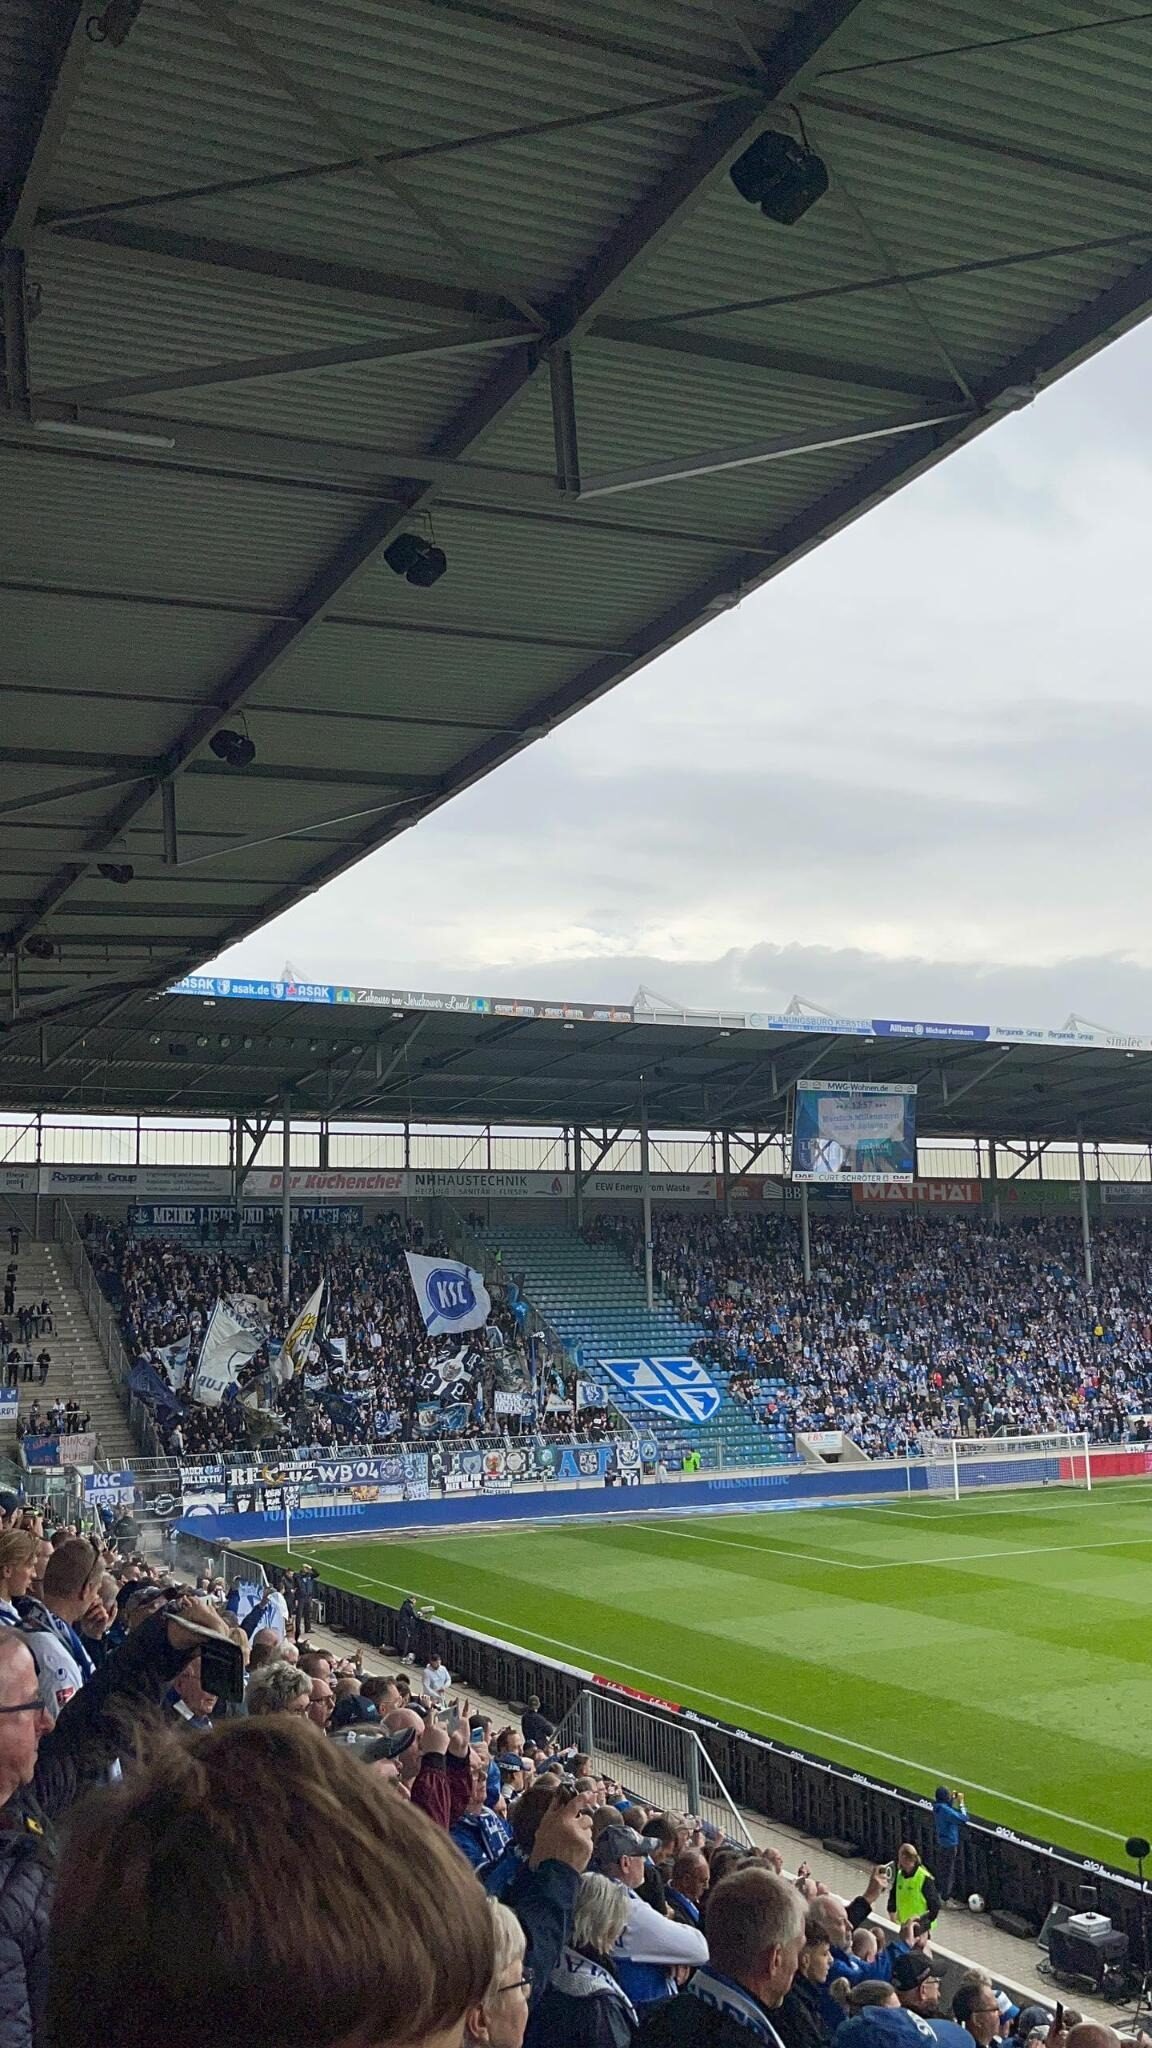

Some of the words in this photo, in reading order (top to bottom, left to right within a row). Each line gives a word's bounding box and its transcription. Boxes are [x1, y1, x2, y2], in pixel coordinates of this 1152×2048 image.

[181, 977, 215, 990] ASAK
[232, 983, 270, 996] asak.de
[298, 986, 330, 998] ASAK
[889, 1023, 914, 1034] Allianz
[827, 1082, 889, 1092] MWG-Wohnen.de
[107, 1172, 138, 1184] Group
[269, 1174, 301, 1189] Dr
[304, 1173, 404, 1190] Küchenchef
[818, 1174, 839, 1182] CURT
[841, 1174, 880, 1183] SCHRÖTER
[595, 1182, 613, 1191] EEW
[614, 1182, 643, 1193] Energy
[665, 1184, 691, 1193] Waste
[153, 1207, 196, 1225] MEINE
[436, 1280, 467, 1309] KSC
[93, 1472, 121, 1488] KSC
[89, 1489, 130, 1505] Freak
